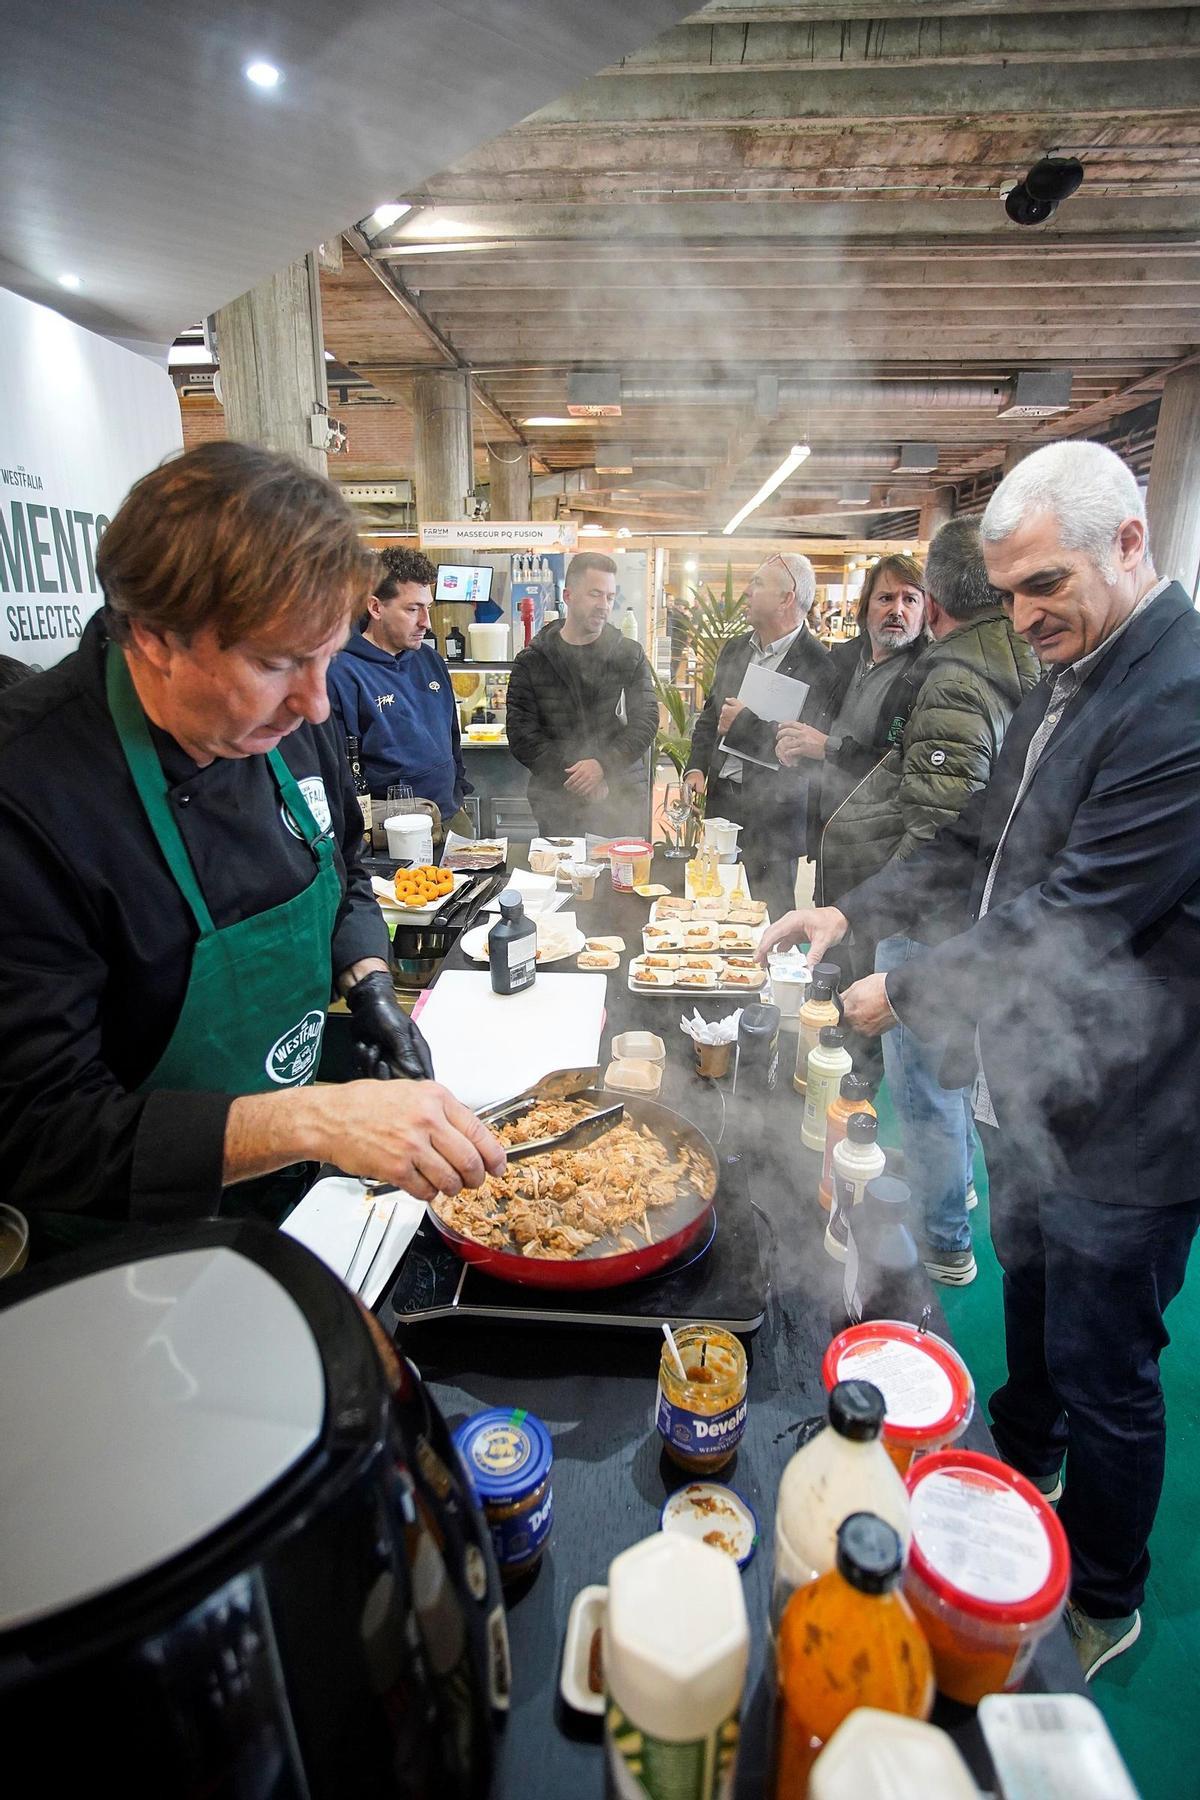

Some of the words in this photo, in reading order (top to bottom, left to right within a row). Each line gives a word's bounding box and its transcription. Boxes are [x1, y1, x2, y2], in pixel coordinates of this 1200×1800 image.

[1, 468, 44, 491] WESTFALIA
[456, 530, 499, 538] MASSEGUR
[500, 530, 513, 539] PQ
[514, 530, 544, 538] FUSION
[6, 604, 83, 642] SELECTES
